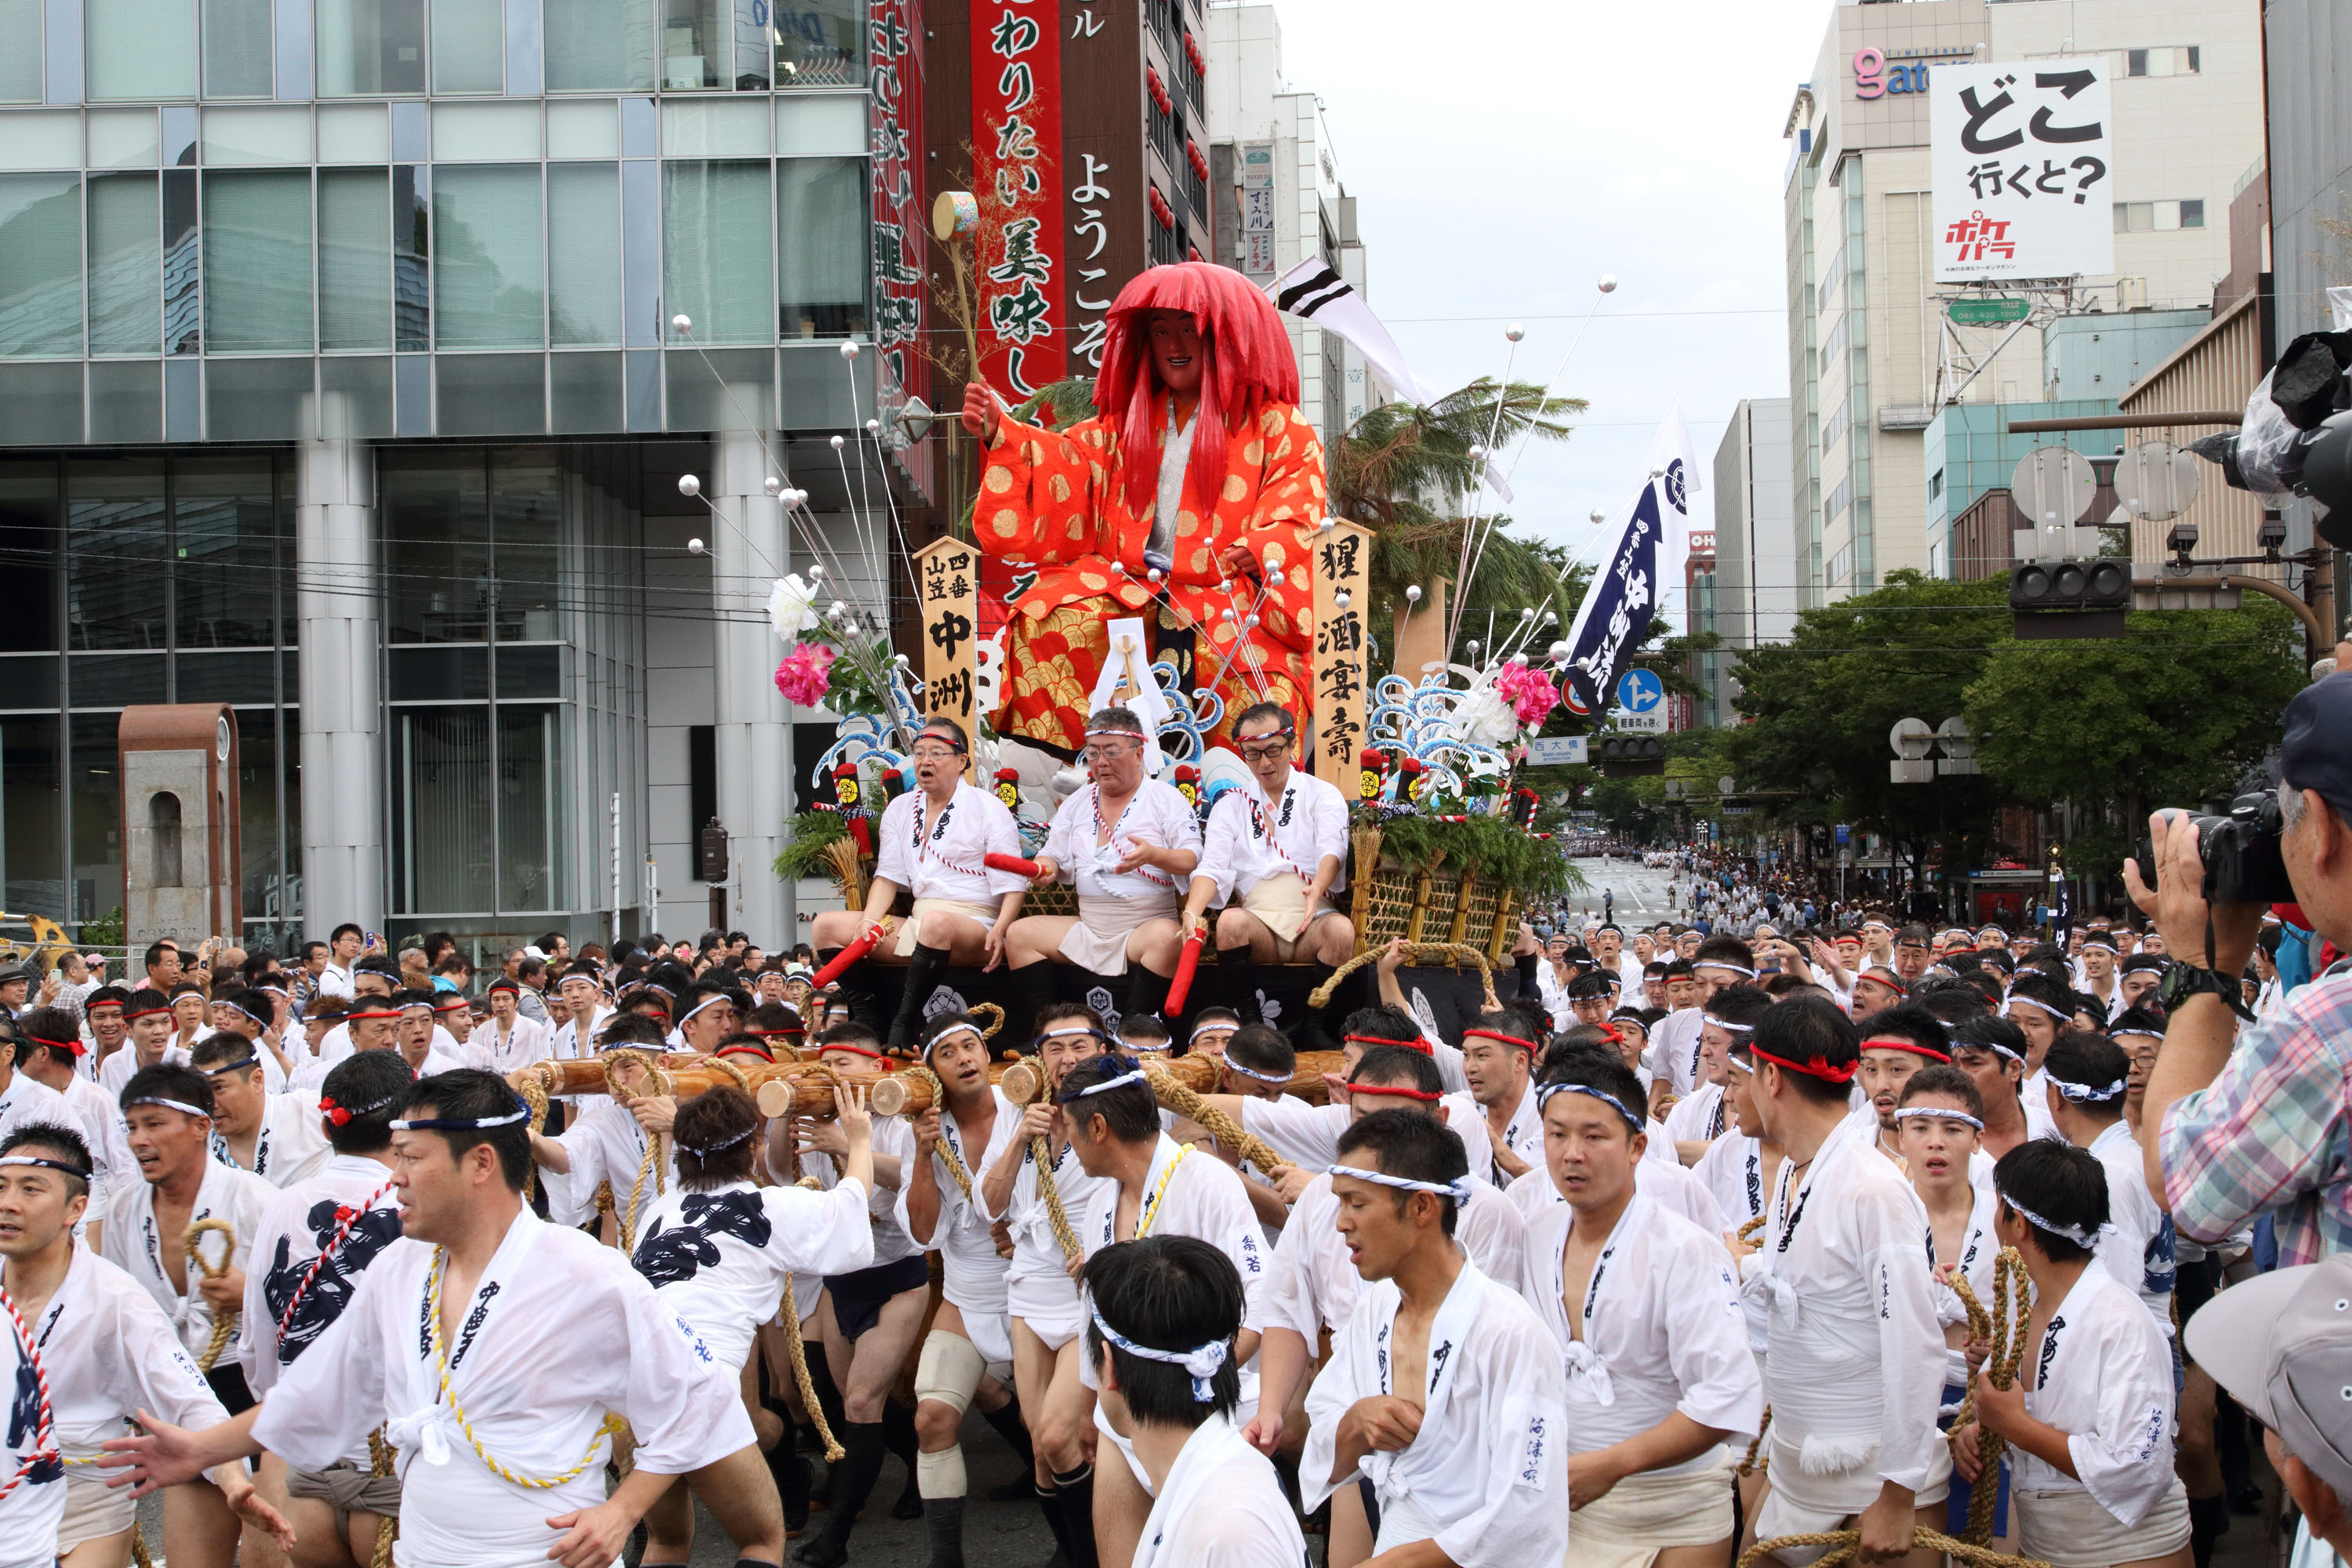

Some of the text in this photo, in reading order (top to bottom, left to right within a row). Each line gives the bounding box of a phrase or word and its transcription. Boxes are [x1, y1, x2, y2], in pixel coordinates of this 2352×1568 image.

[1958, 69, 2103, 154] どこ
[988, 0, 1052, 428] わりたい美味し
[1250, 191, 1262, 228] すみ川
[1072, 154, 1112, 368] ようこそ
[925, 555, 948, 602] 山笠
[948, 552, 973, 599] 四番
[929, 610, 973, 718] 中洲
[1534, 740, 1578, 751] 西大橋
[1621, 717, 1661, 729] 軽車両を除く
